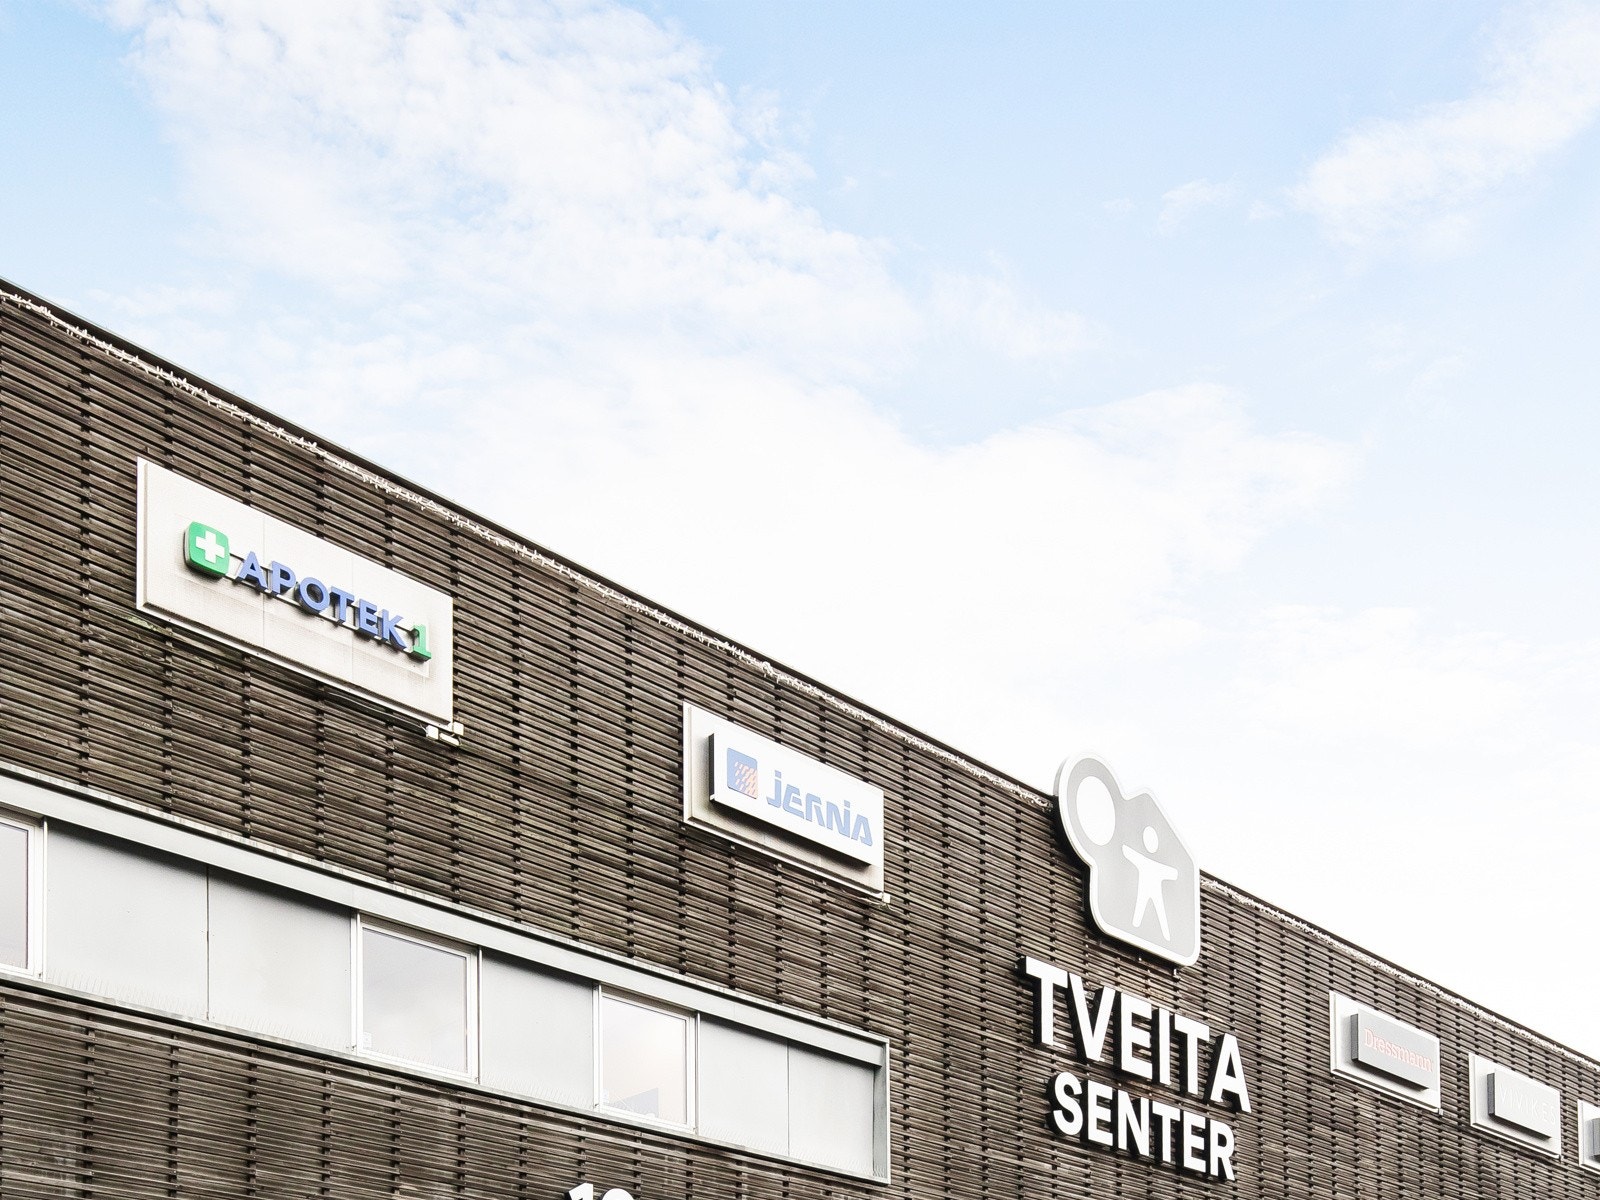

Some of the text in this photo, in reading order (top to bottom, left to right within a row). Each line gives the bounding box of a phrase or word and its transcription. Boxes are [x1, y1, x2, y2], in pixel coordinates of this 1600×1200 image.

[237, 551, 432, 662] APOTEK 1
[1025, 955, 1252, 1114] TVEITA
[1364, 1028, 1433, 1073] Dressmann
[1052, 1071, 1236, 1182] SENTER
